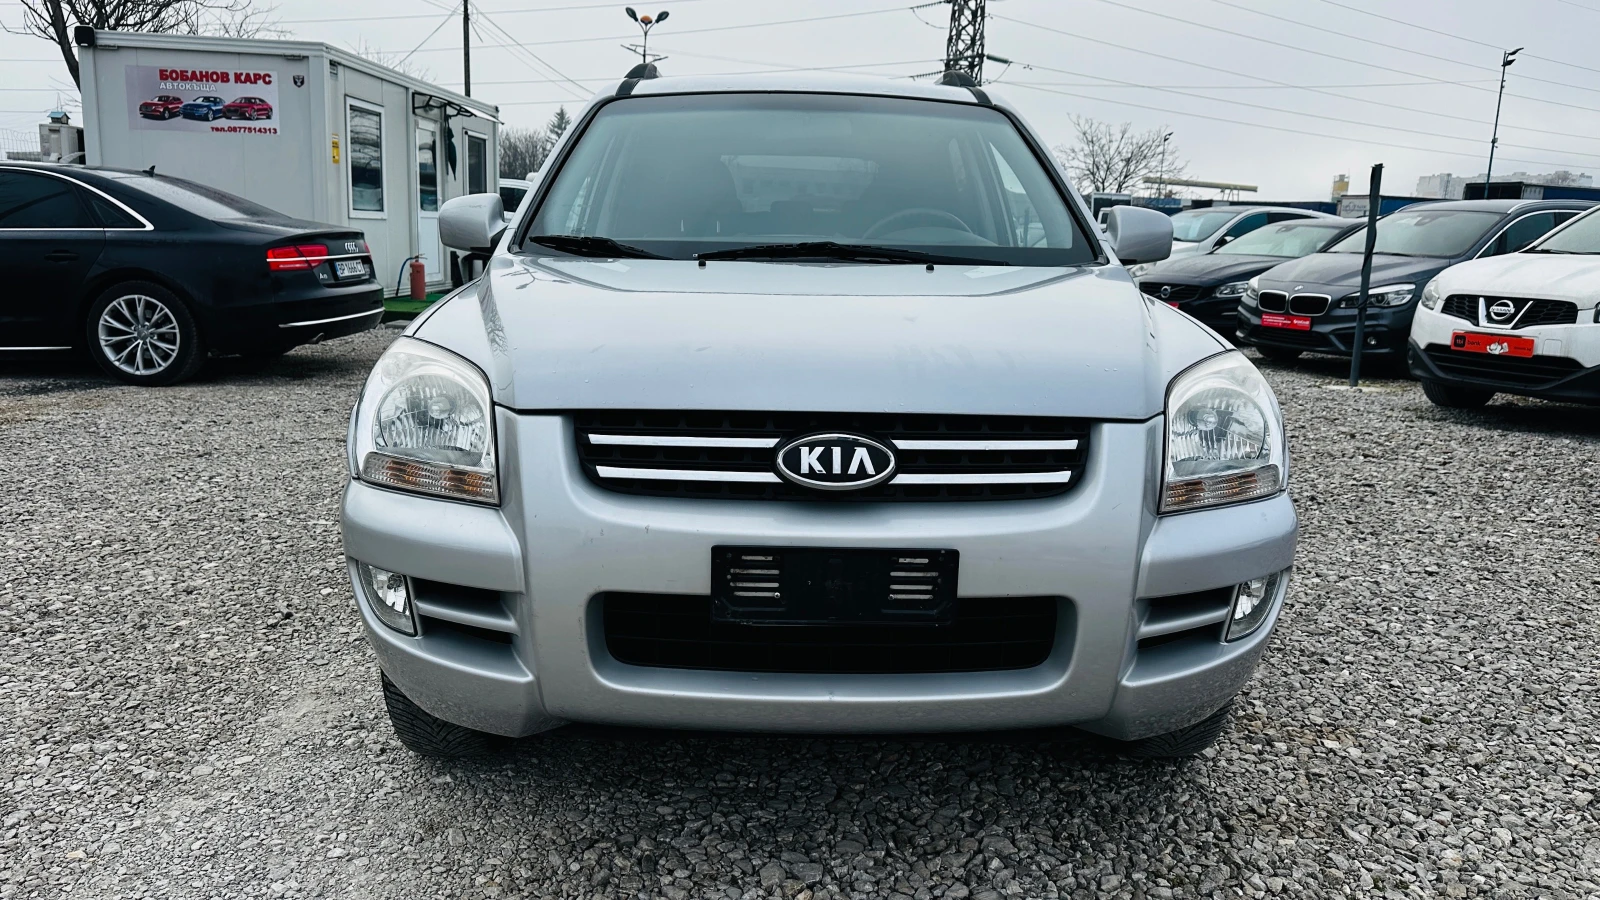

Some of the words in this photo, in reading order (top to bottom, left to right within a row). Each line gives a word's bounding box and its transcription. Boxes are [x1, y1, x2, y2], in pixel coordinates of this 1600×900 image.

[159, 69, 230, 83] БОБАНОВ
[234, 72, 272, 85] КАРС
[160, 82, 217, 92] АВТОКЪЩА
[799, 446, 876, 475] KIA
